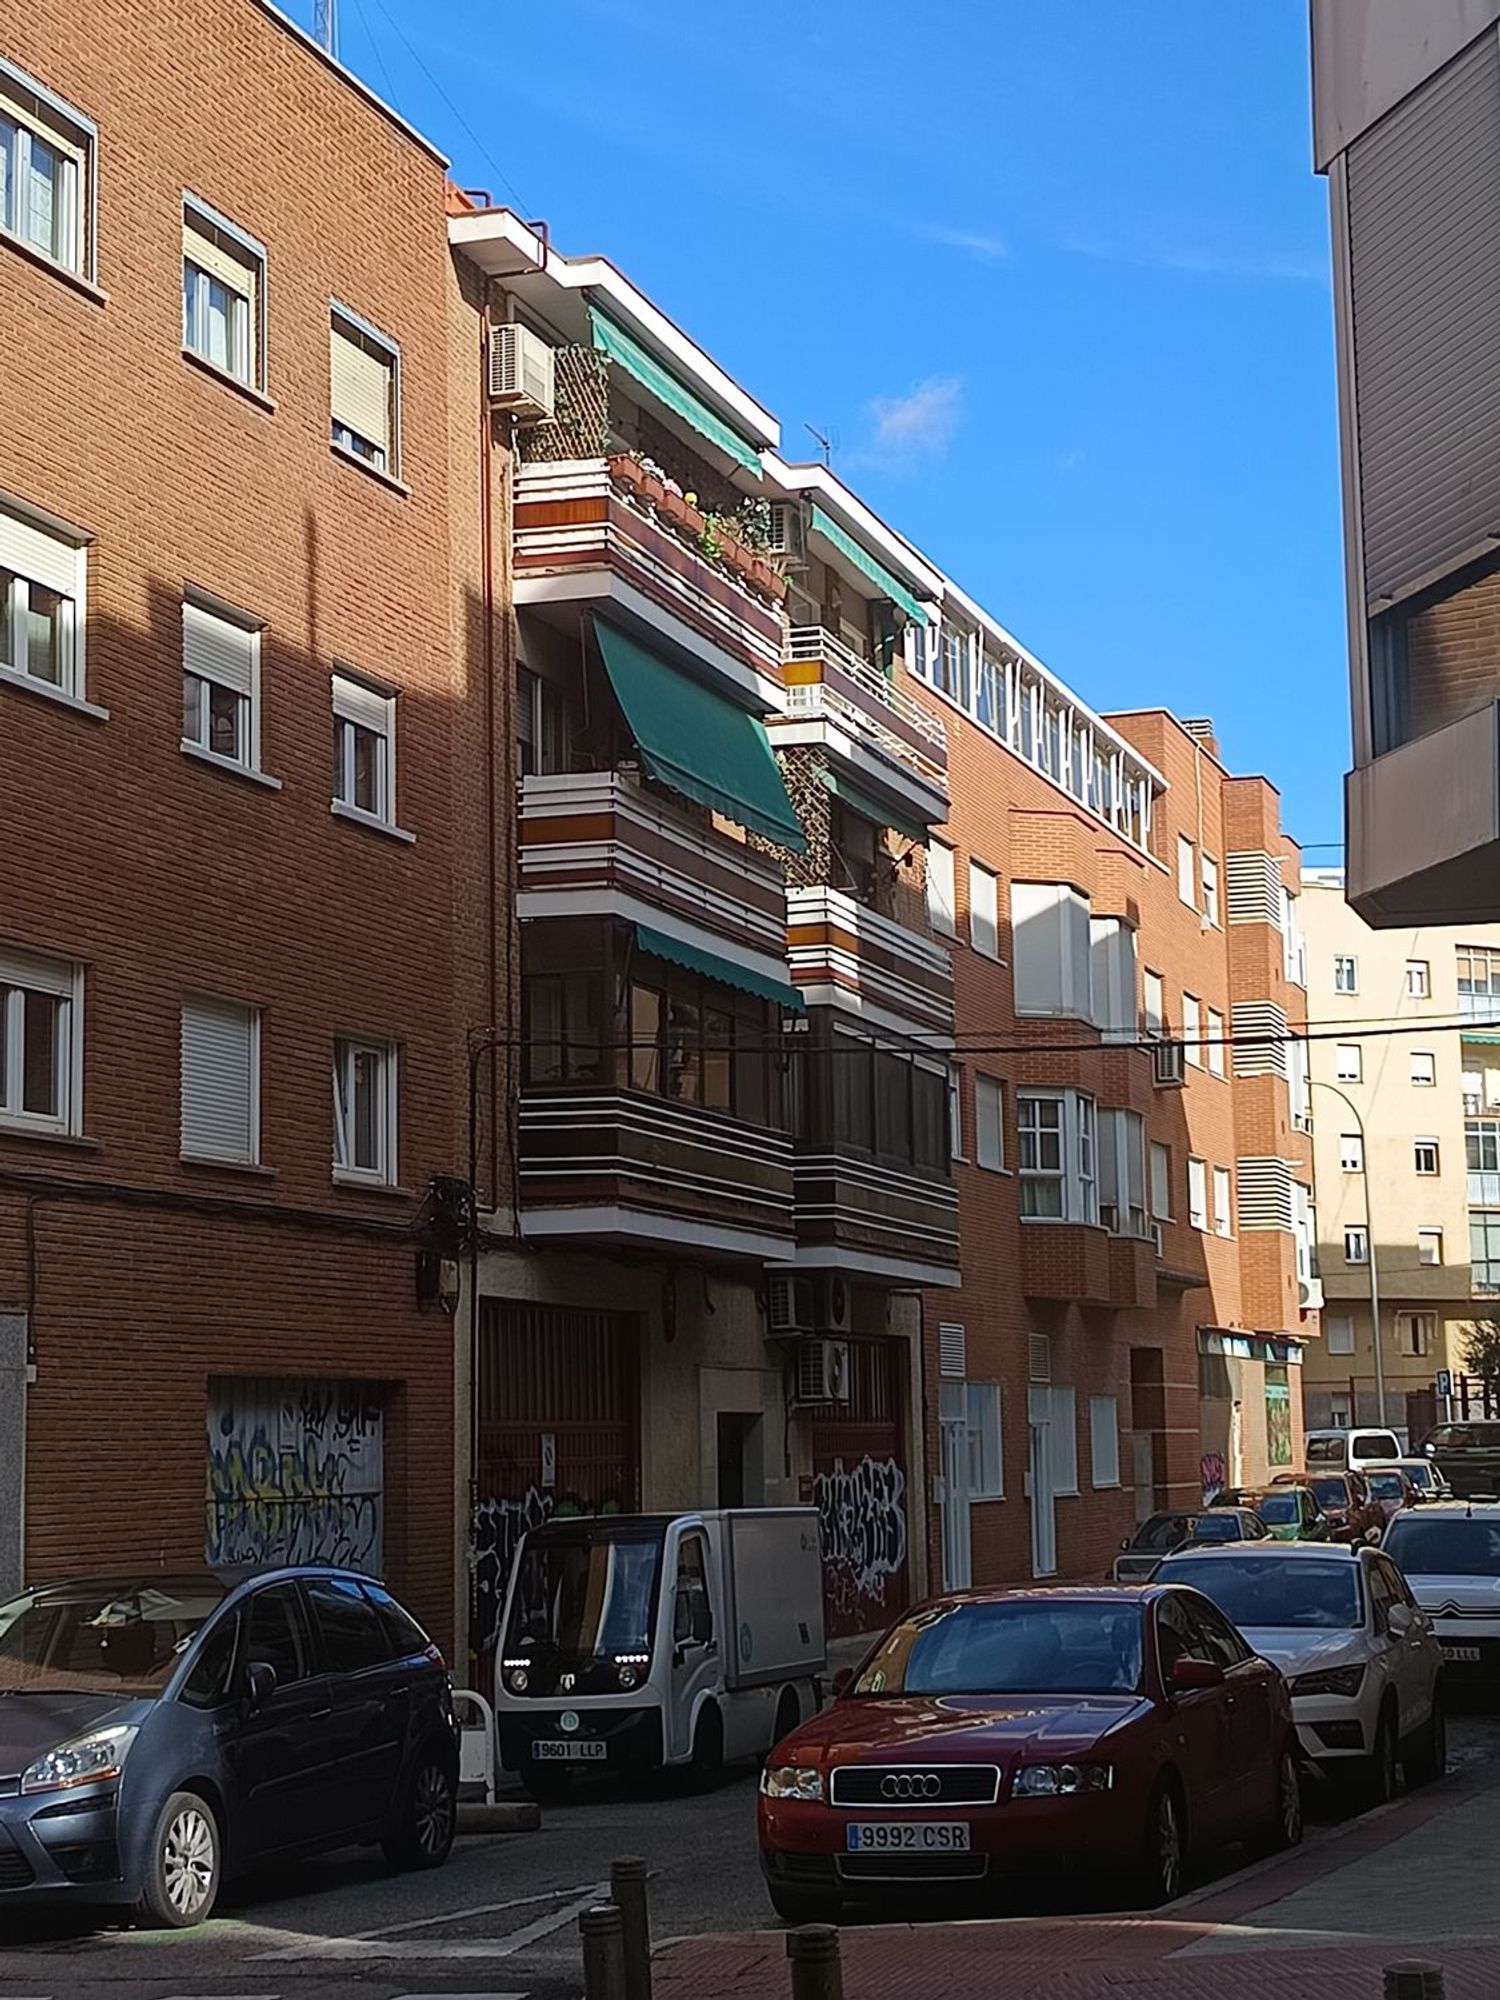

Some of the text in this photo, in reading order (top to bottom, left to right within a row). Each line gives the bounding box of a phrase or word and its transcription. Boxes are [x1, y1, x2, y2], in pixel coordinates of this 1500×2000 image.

[1440, 1373, 1448, 1392] P
[542, 1743, 603, 1756] 9601 LLP
[862, 1826, 965, 1848] 9992 CSR
